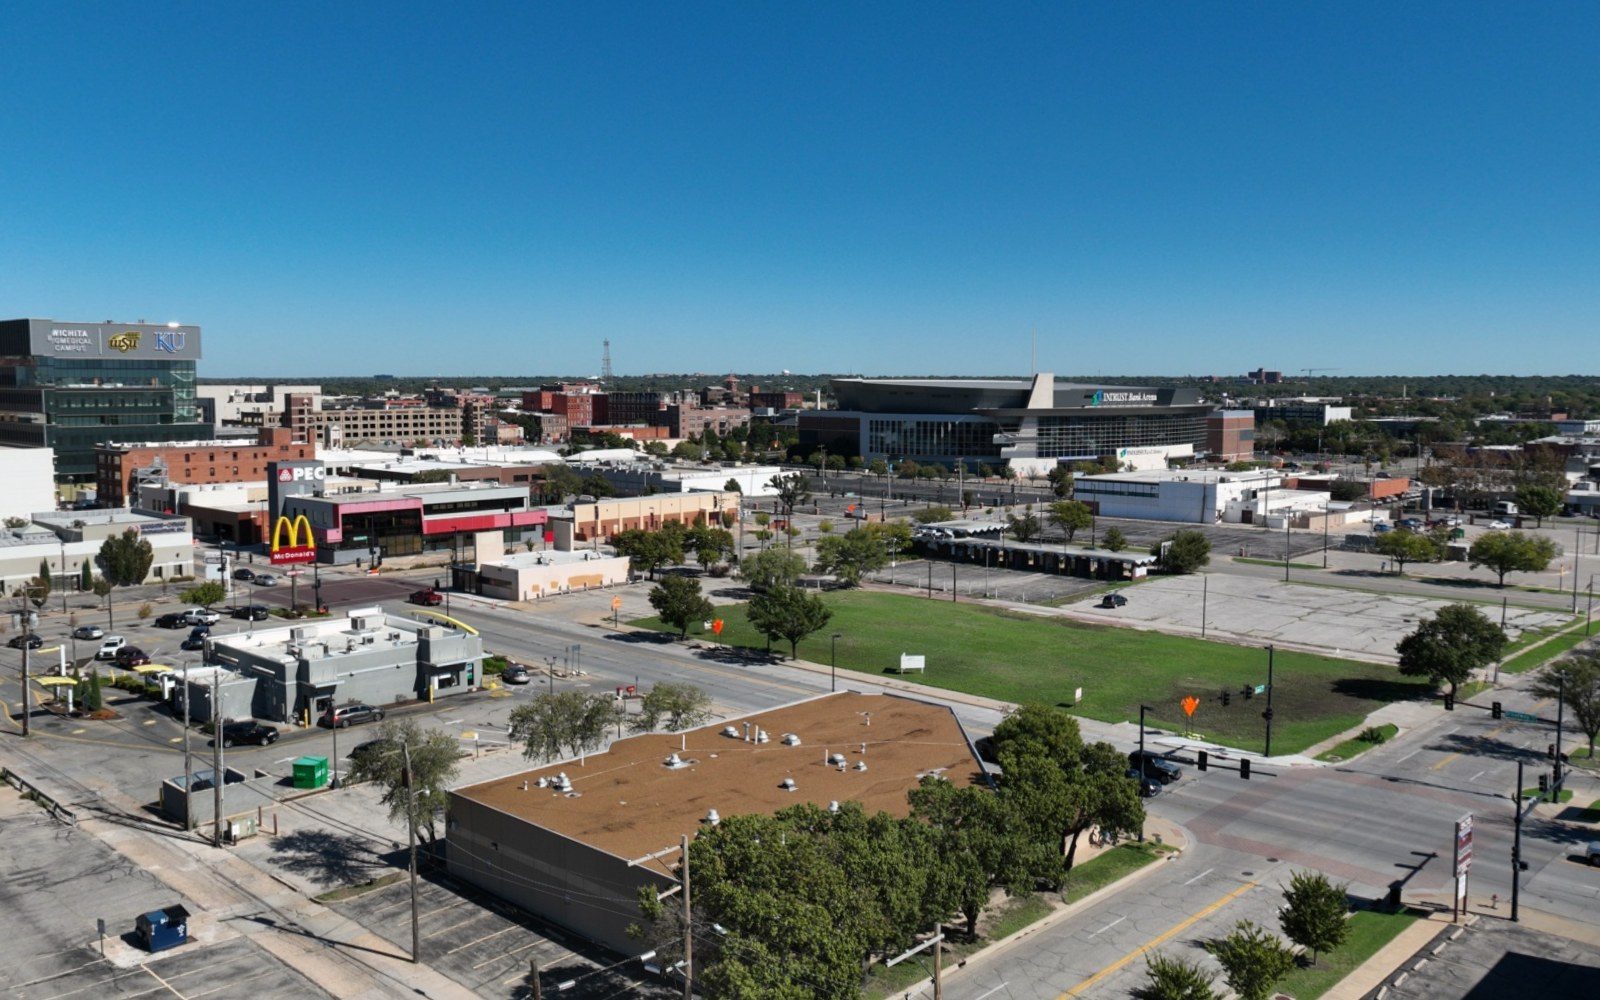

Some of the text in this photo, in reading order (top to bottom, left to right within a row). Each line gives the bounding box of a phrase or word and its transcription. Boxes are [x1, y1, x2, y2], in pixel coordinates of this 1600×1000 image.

[52, 329, 88, 337] WICHITA
[153, 331, 186, 353] KU
[292, 466, 324, 480] PEC
[273, 551, 315, 560] McDonald's
